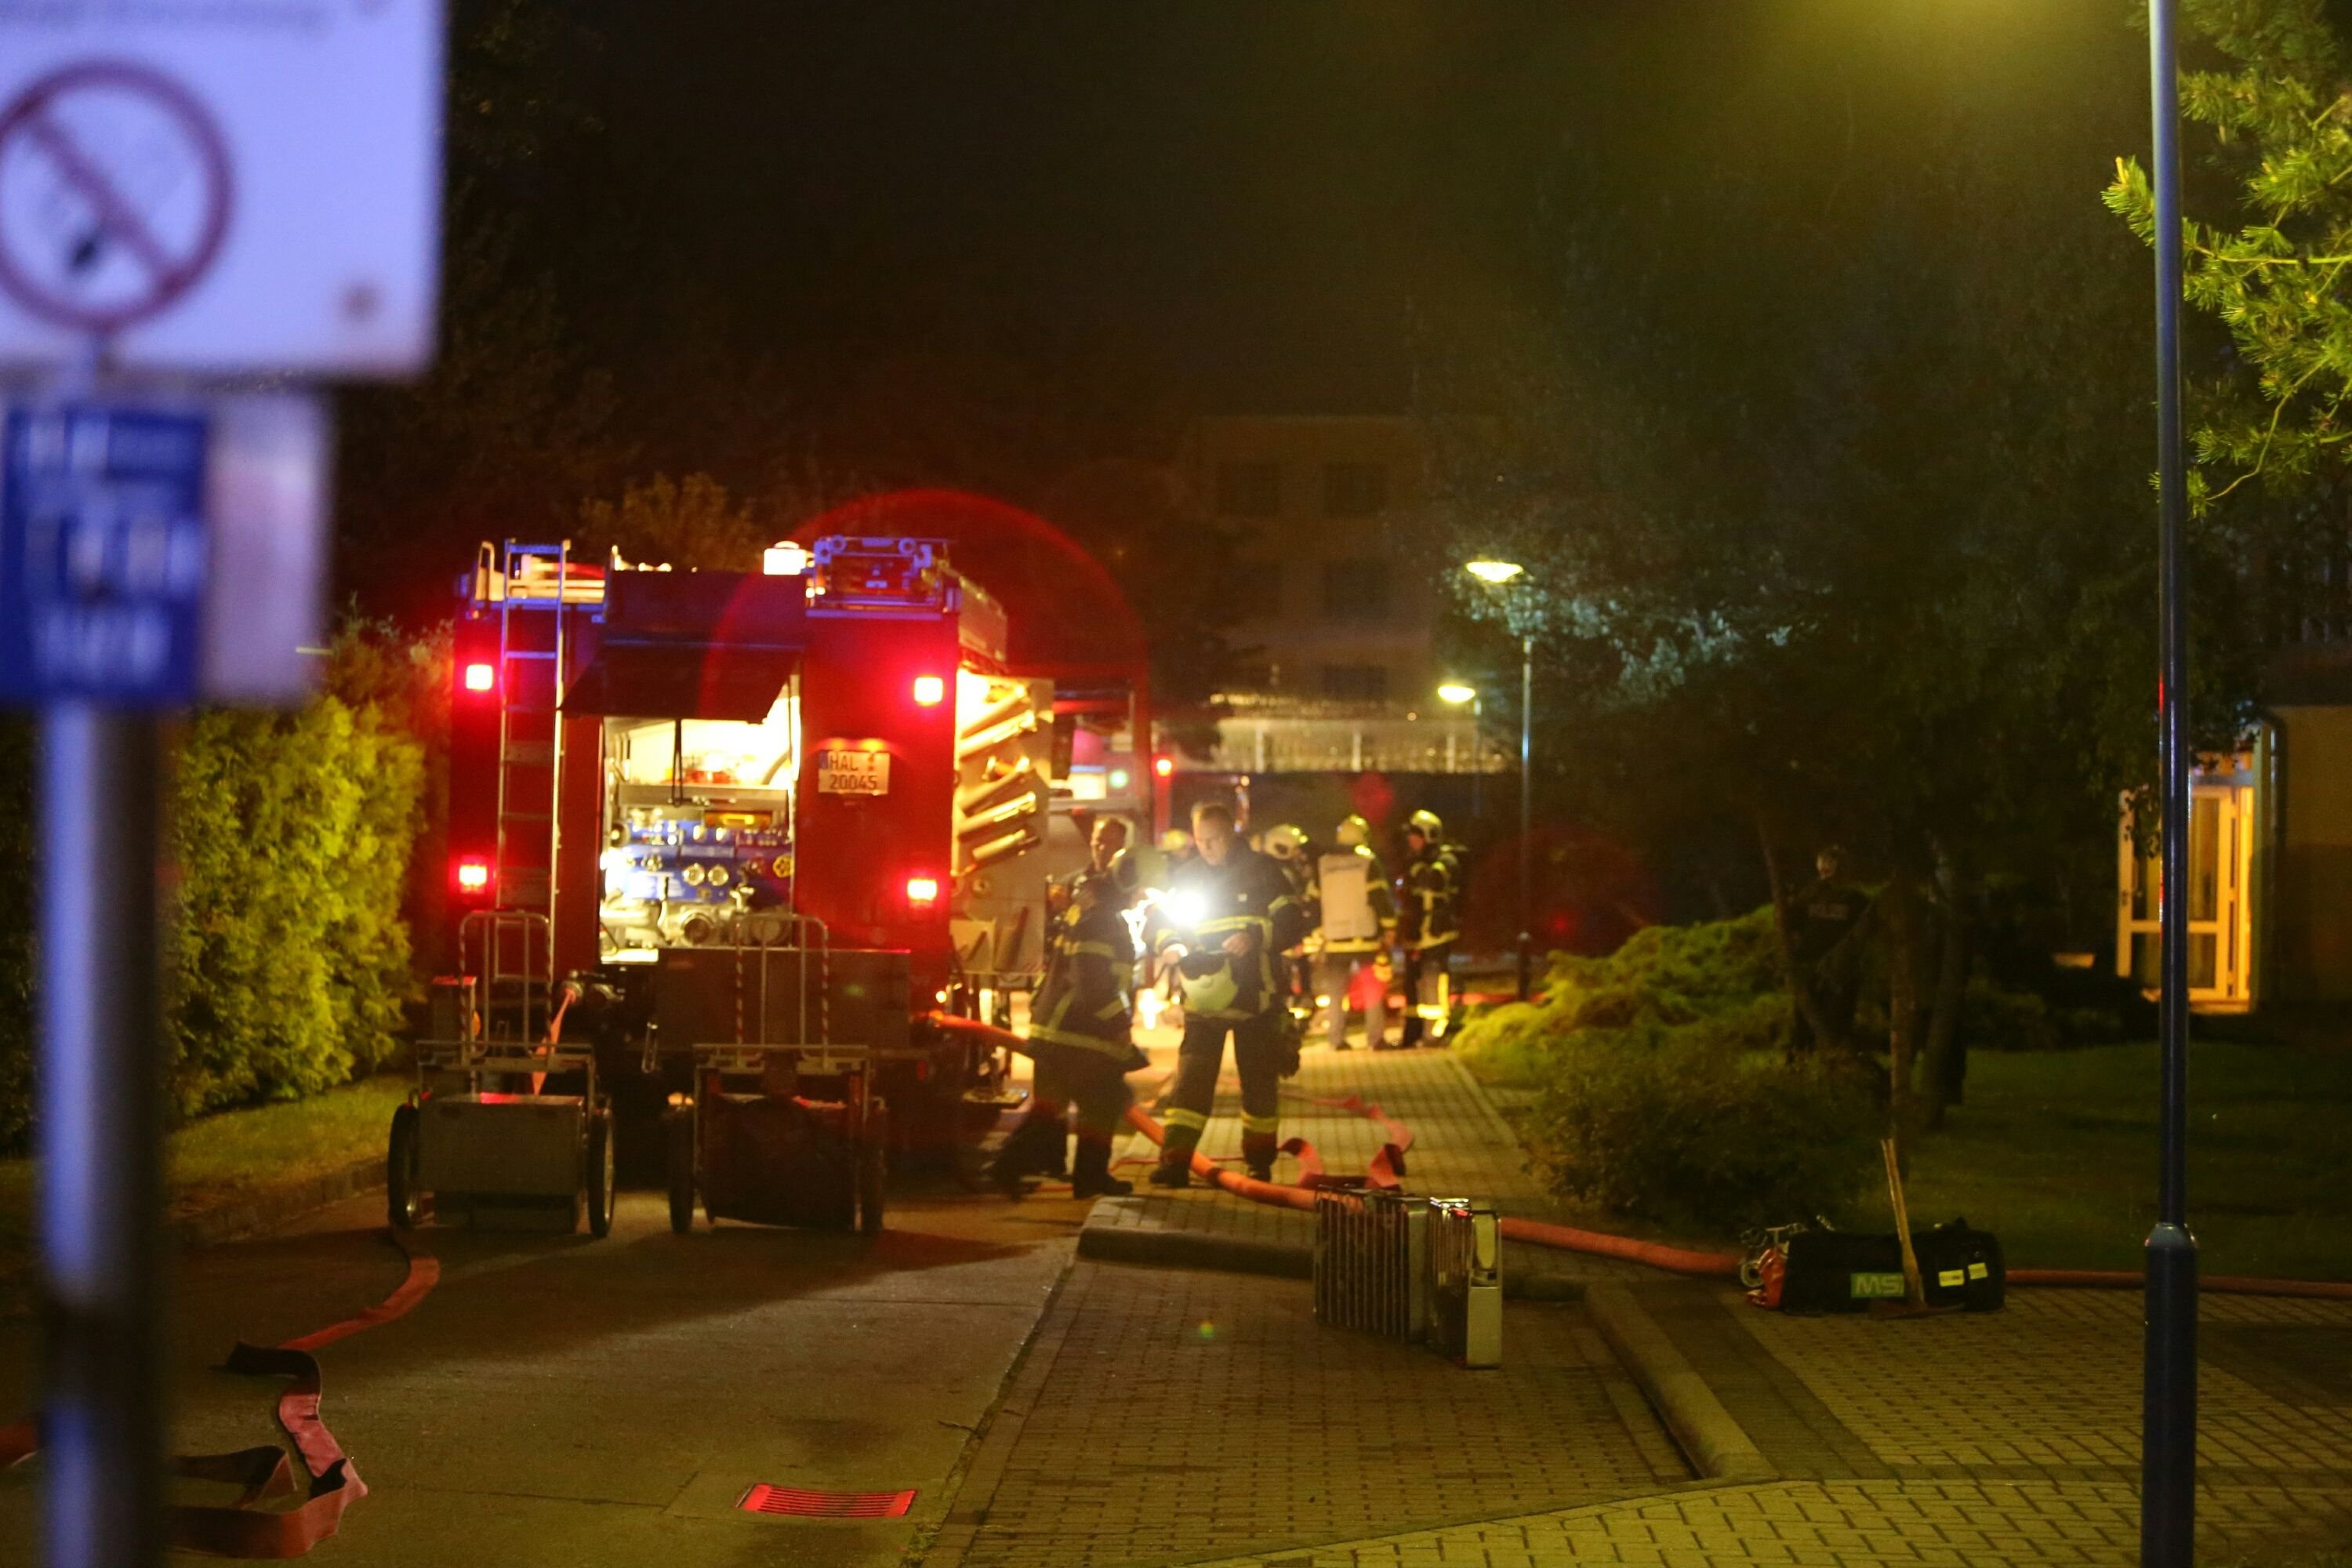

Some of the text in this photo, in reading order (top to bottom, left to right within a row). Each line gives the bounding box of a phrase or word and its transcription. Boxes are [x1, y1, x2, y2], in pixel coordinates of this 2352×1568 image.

[829, 754, 858, 771] HAL
[829, 774, 878, 790] 20045
[1855, 1273, 1904, 1295] MS
